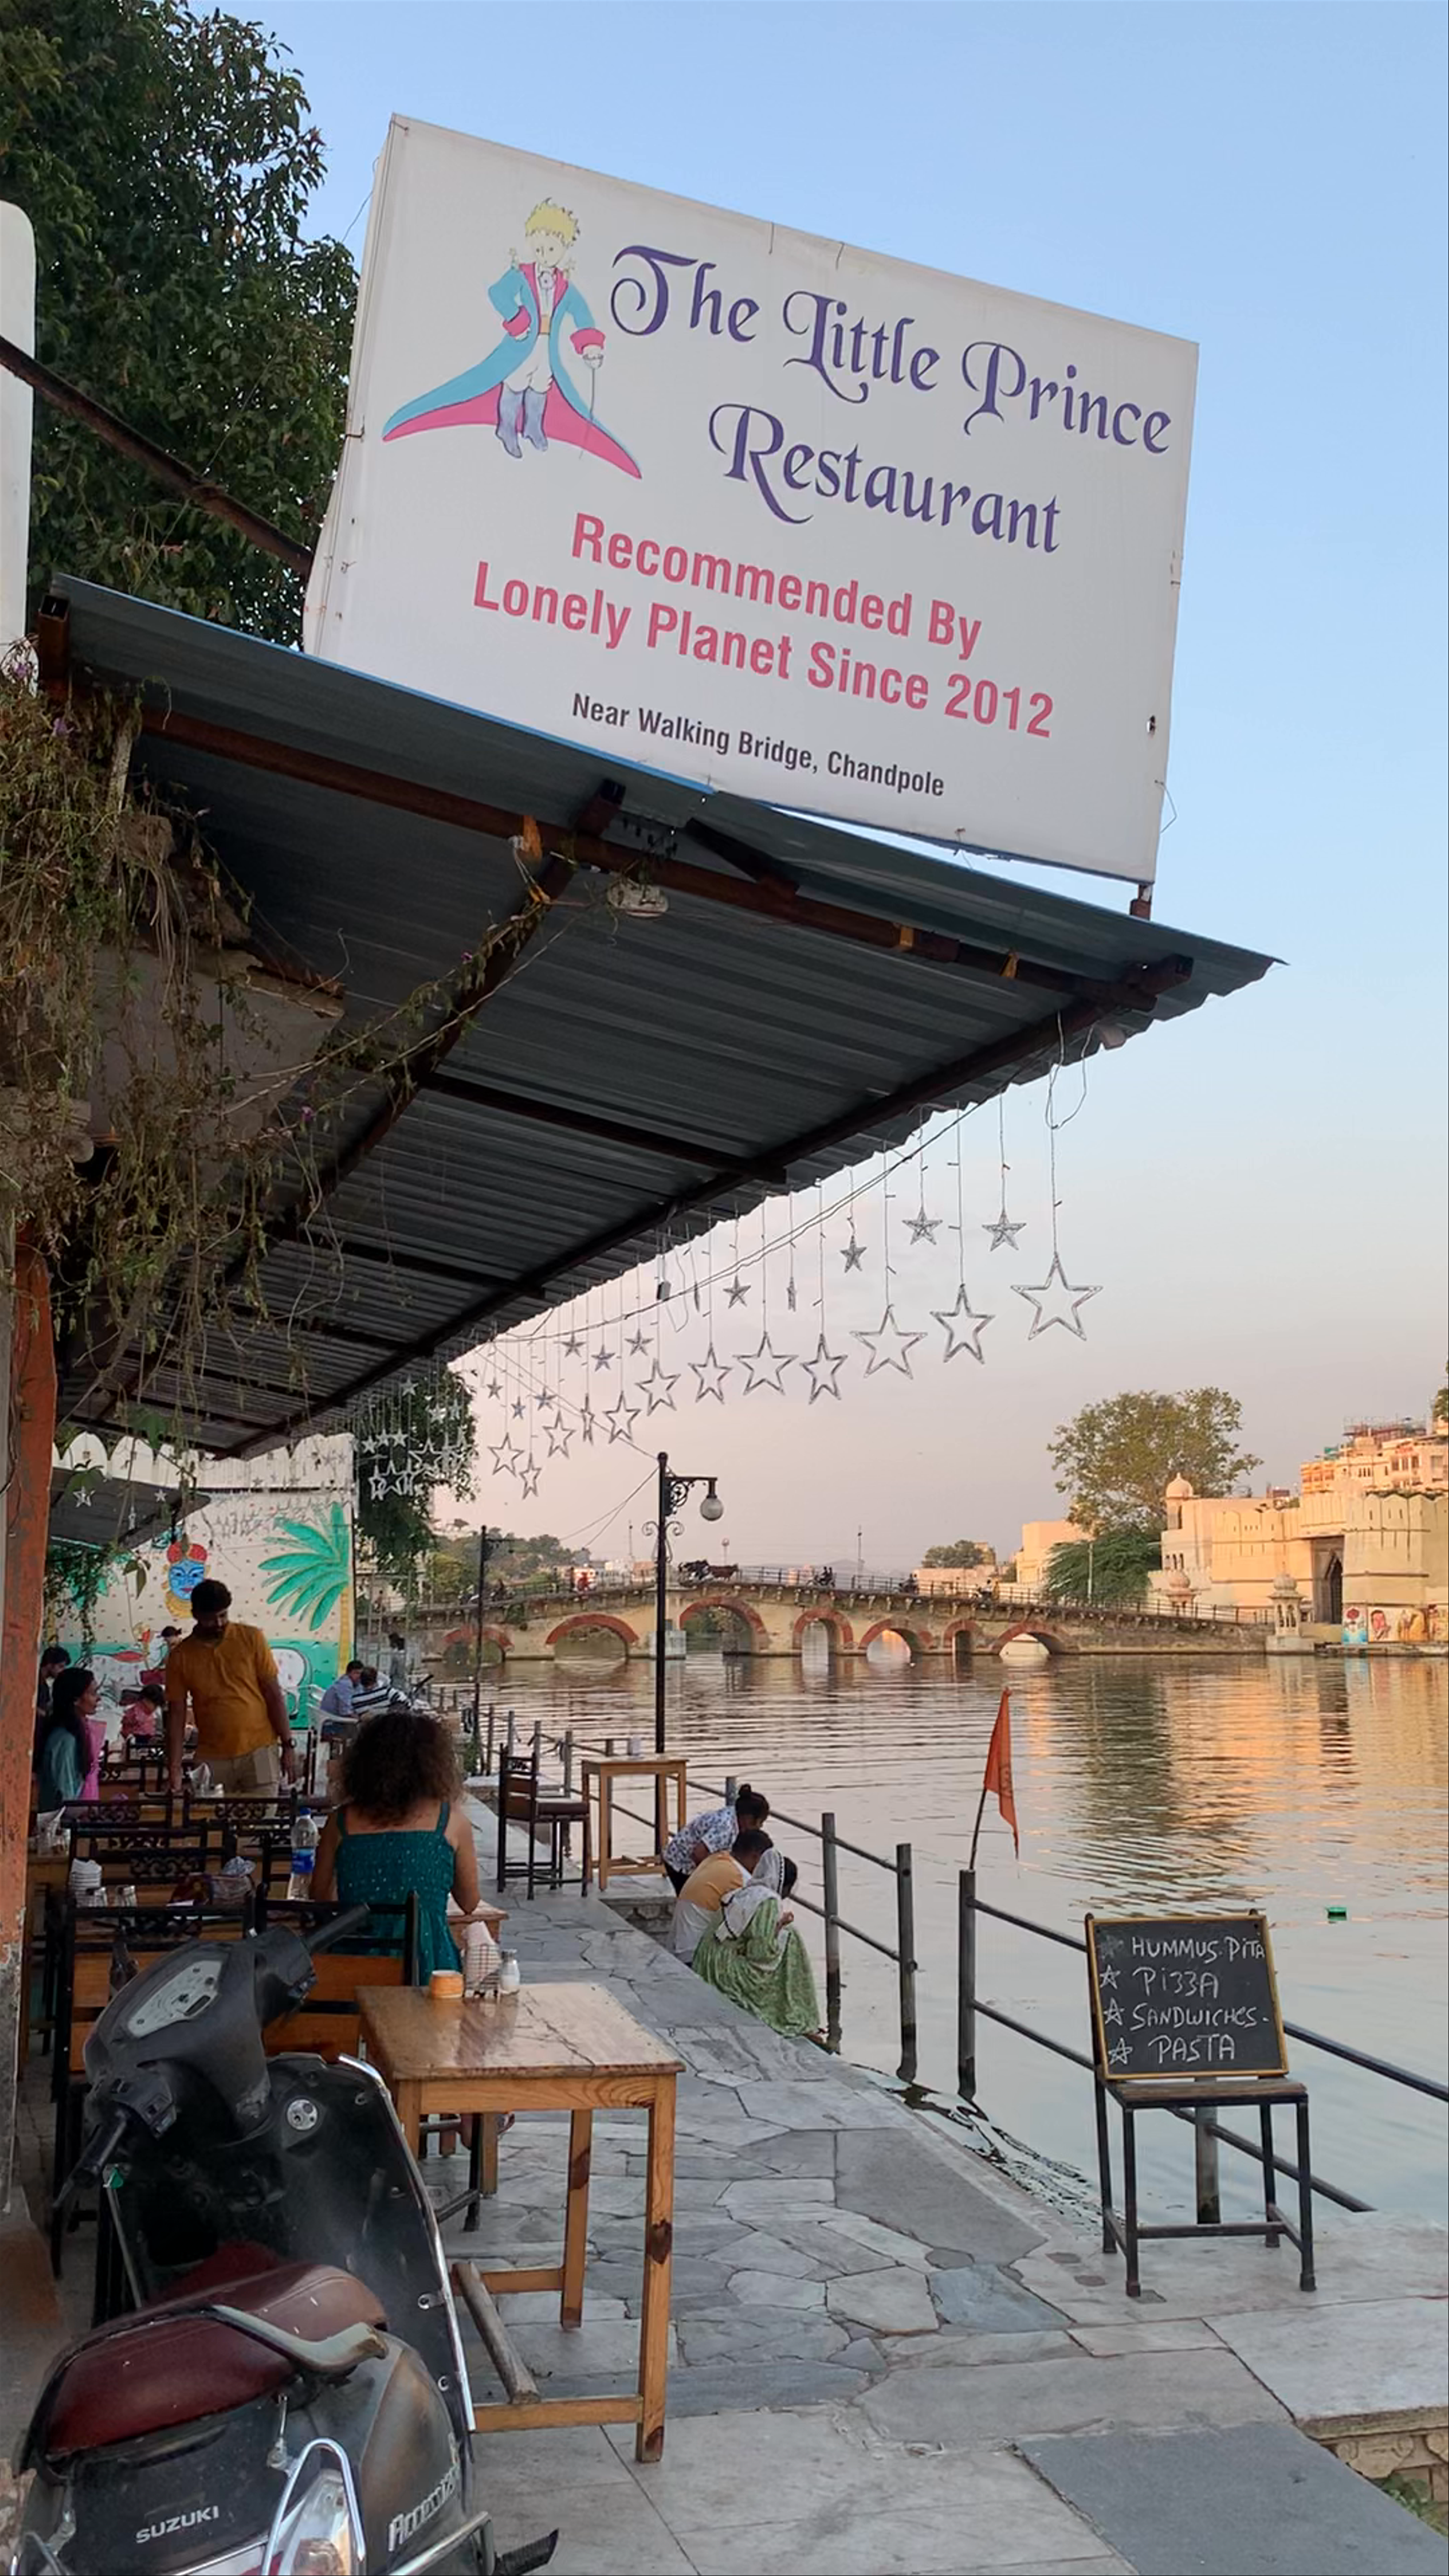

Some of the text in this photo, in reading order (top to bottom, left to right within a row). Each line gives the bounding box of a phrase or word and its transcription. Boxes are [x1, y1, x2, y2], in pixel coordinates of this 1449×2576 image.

[611, 245, 1171, 454] The Little Prince
[709, 404, 1060, 553] Restaurant
[474, 562, 1052, 738] Lonely Planet Since 2012
[572, 512, 981, 660] Recommended By
[572, 693, 944, 796] Near Walking Bridge, Chandpole
[1148, 2034, 1235, 2064] PASTA
[135, 2505, 219, 2544] SUZUKI
